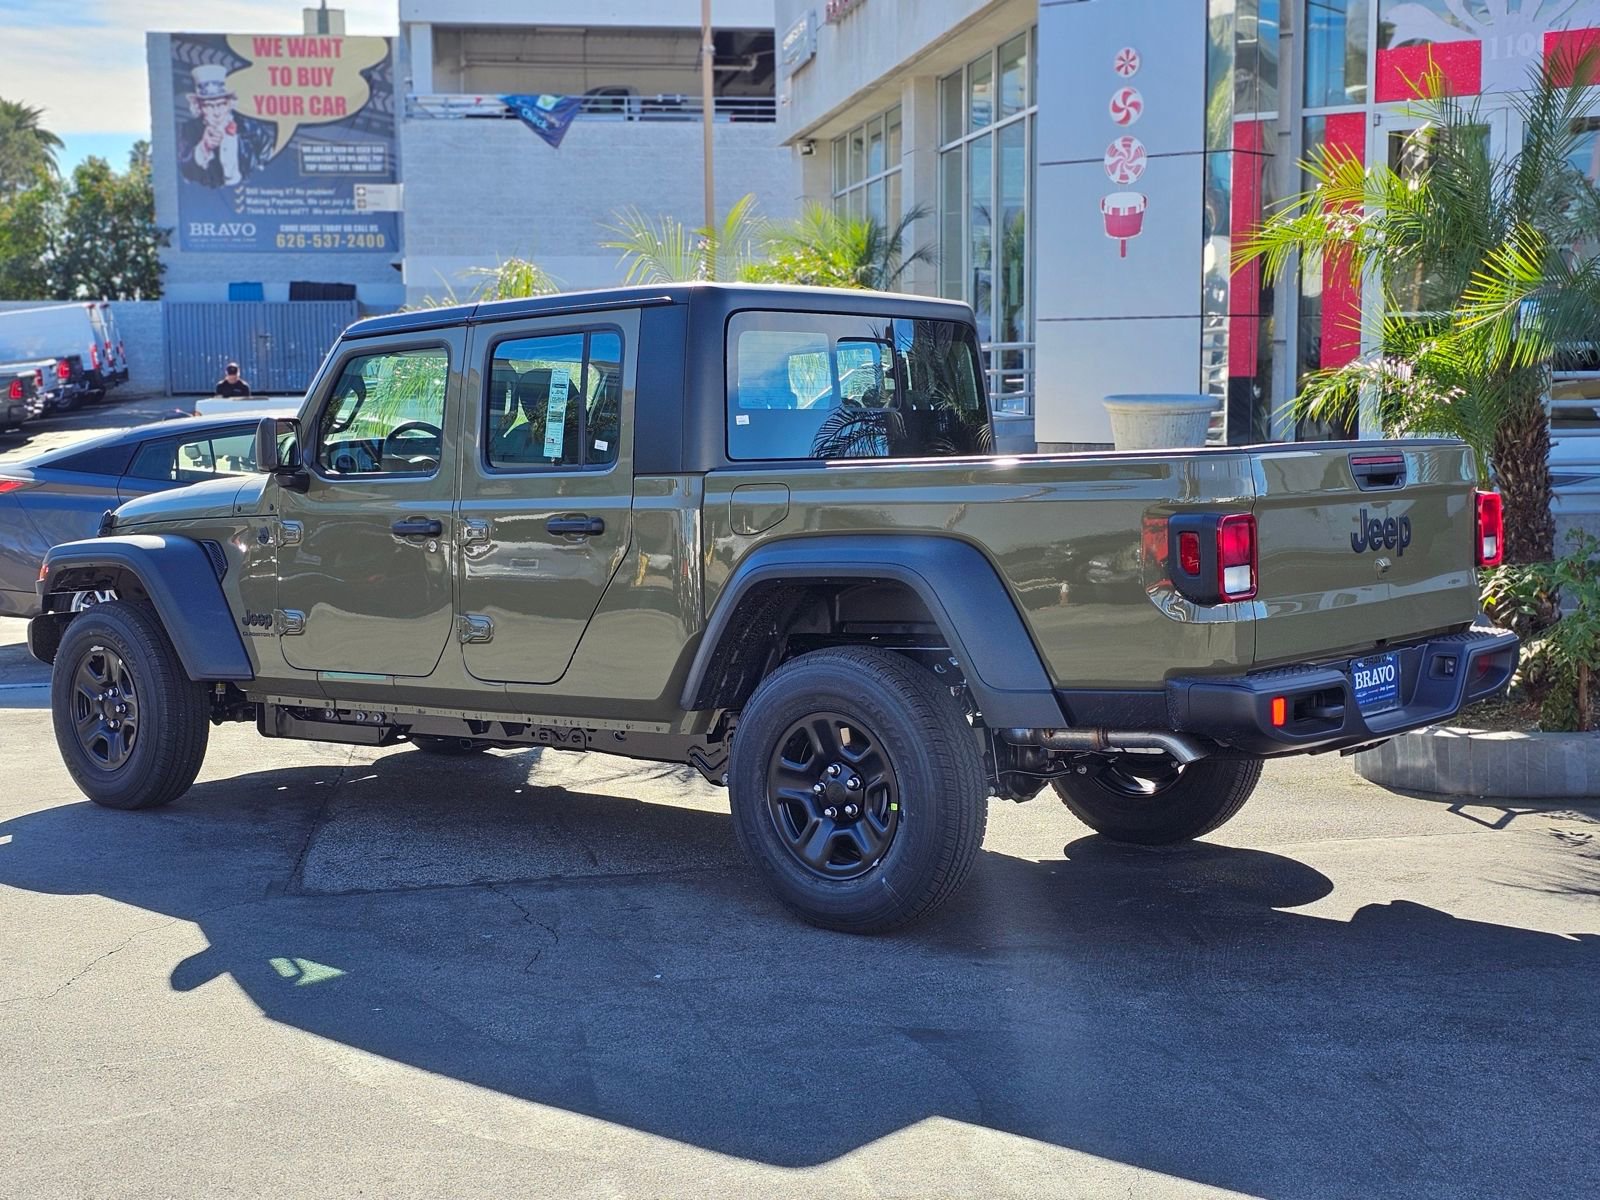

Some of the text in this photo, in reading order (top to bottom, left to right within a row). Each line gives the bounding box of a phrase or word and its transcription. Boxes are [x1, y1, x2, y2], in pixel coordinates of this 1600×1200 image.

[253, 37, 344, 59] WE WANT
[268, 66, 334, 87] TO BUY
[253, 95, 347, 116] YOUR CAR
[189, 222, 257, 237] BRAVO
[276, 233, 385, 249] 626-537-2400
[1350, 508, 1412, 557] Jeep
[242, 609, 273, 630] Jeep
[1354, 664, 1395, 690] BRAVO
